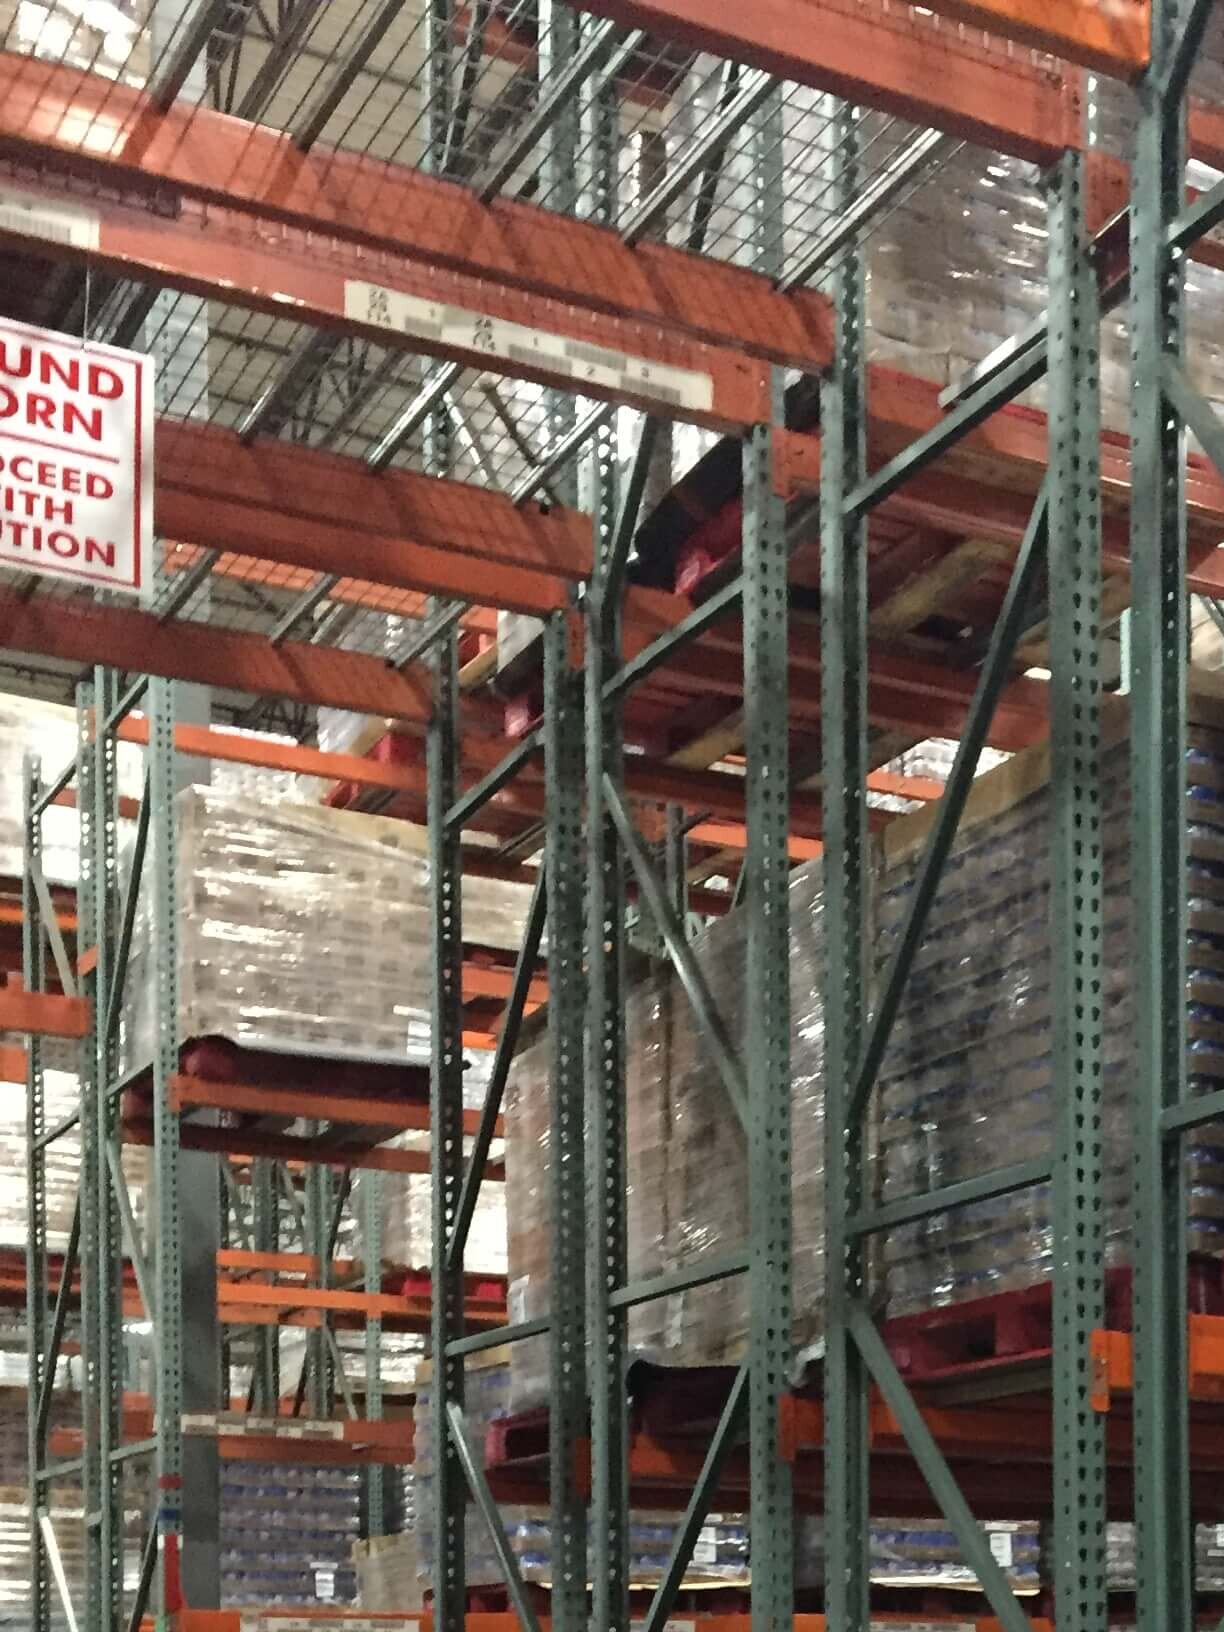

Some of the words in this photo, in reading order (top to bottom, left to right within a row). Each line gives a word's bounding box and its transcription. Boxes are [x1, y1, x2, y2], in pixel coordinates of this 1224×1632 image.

[0, 456, 114, 499] CEED
[0, 484, 73, 524] ITH
[0, 518, 116, 567] TION
